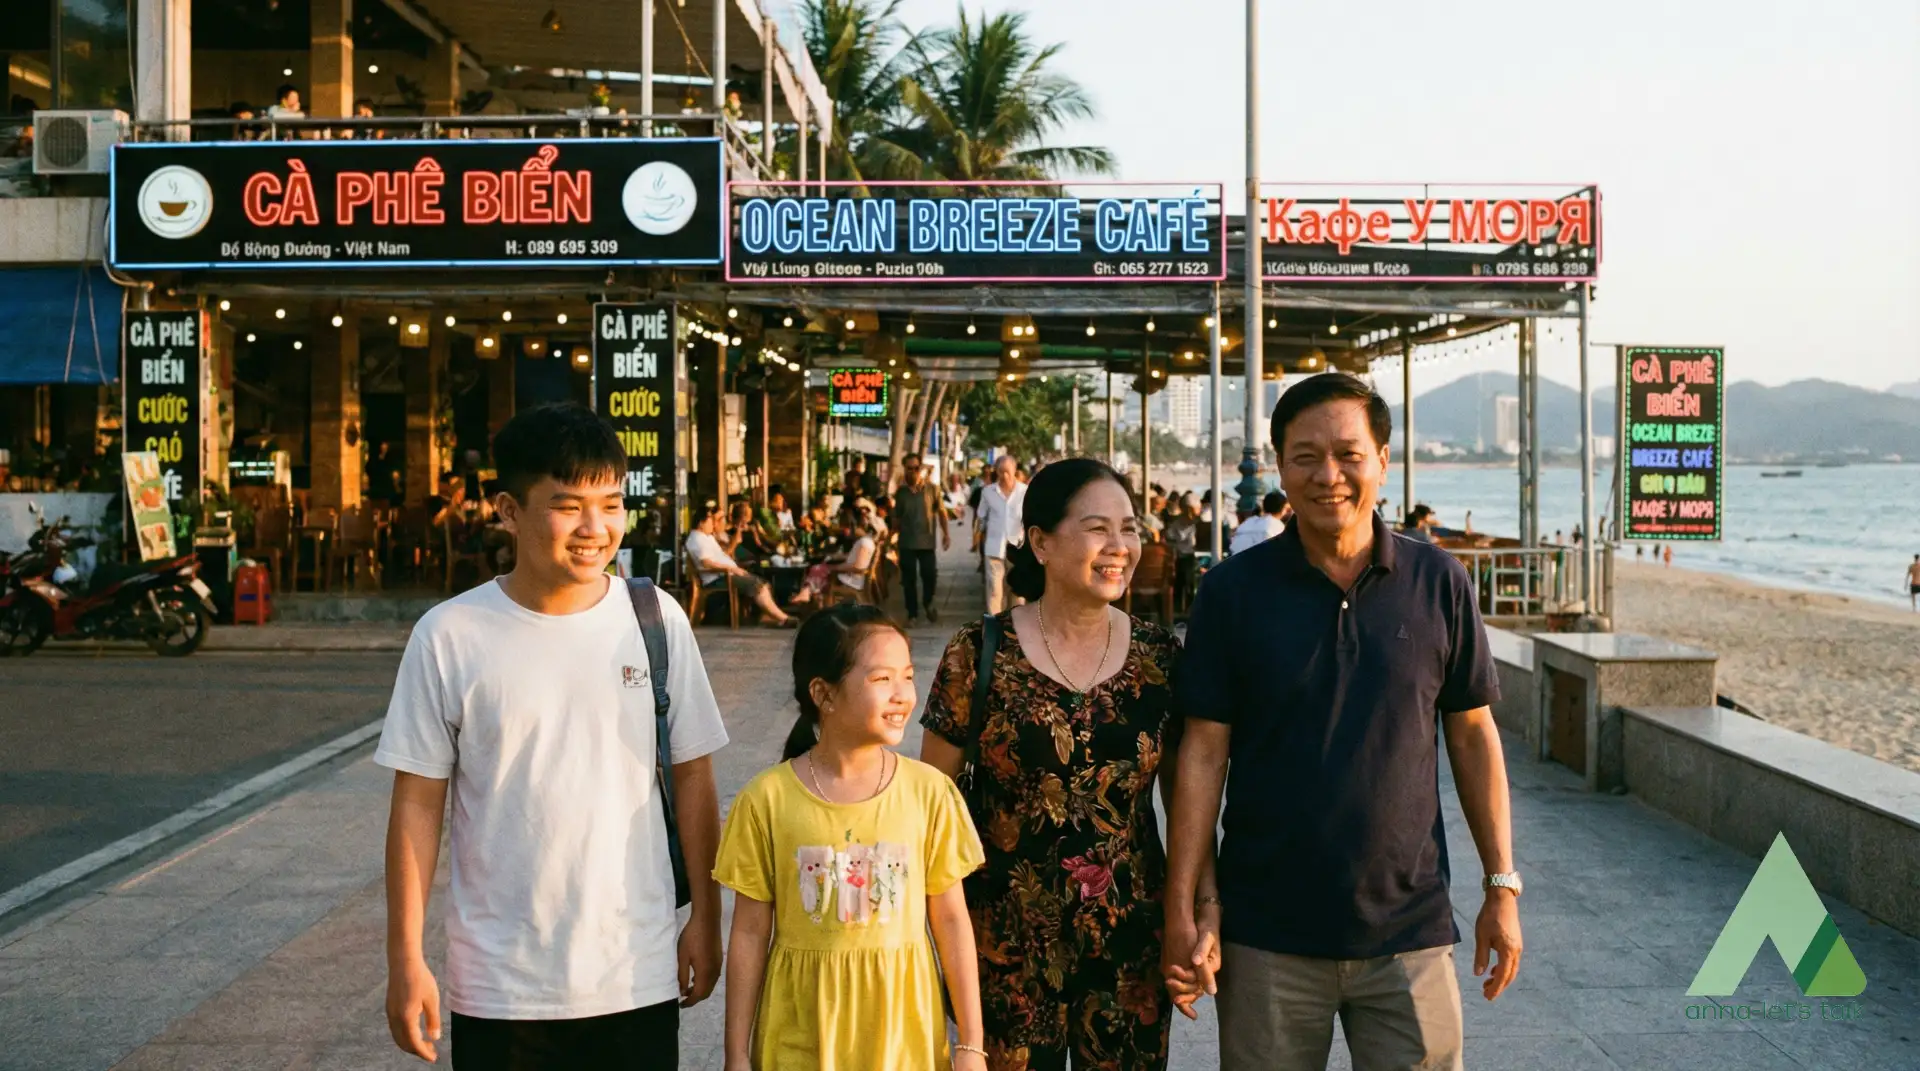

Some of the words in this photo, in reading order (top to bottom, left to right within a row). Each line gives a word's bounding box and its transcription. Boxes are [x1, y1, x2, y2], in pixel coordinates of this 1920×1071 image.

[243, 159, 319, 226] CÀ
[336, 157, 445, 224] PHÊ
[463, 145, 592, 224] BIỂN
[741, 199, 896, 253] OCEAN
[909, 199, 1082, 253] BREEZE
[1094, 188, 1210, 253] CAFÉ
[1265, 197, 1392, 255] Кафе
[1450, 197, 1592, 244] МОРЯ
[377, 241, 411, 256] Nam
[527, 240, 555, 255] 089
[559, 239, 586, 255] 695
[590, 240, 618, 255] 309
[1119, 262, 1145, 275] 065
[1148, 262, 1173, 275] 277
[1177, 262, 1209, 275] 1523
[130, 316, 156, 347] CÀ
[159, 316, 195, 347] PHÊ
[601, 309, 627, 340] CÀ
[631, 308, 668, 340] PHÊ
[141, 349, 185, 384] BIỂN
[613, 342, 657, 378] BIỂN
[1632, 354, 1663, 383] CÀ
[1670, 355, 1715, 384] PHÊ
[1646, 382, 1700, 416] BIỂN
[1632, 423, 1673, 443] OCEAN
[1682, 445, 1714, 469] CAFÉ
